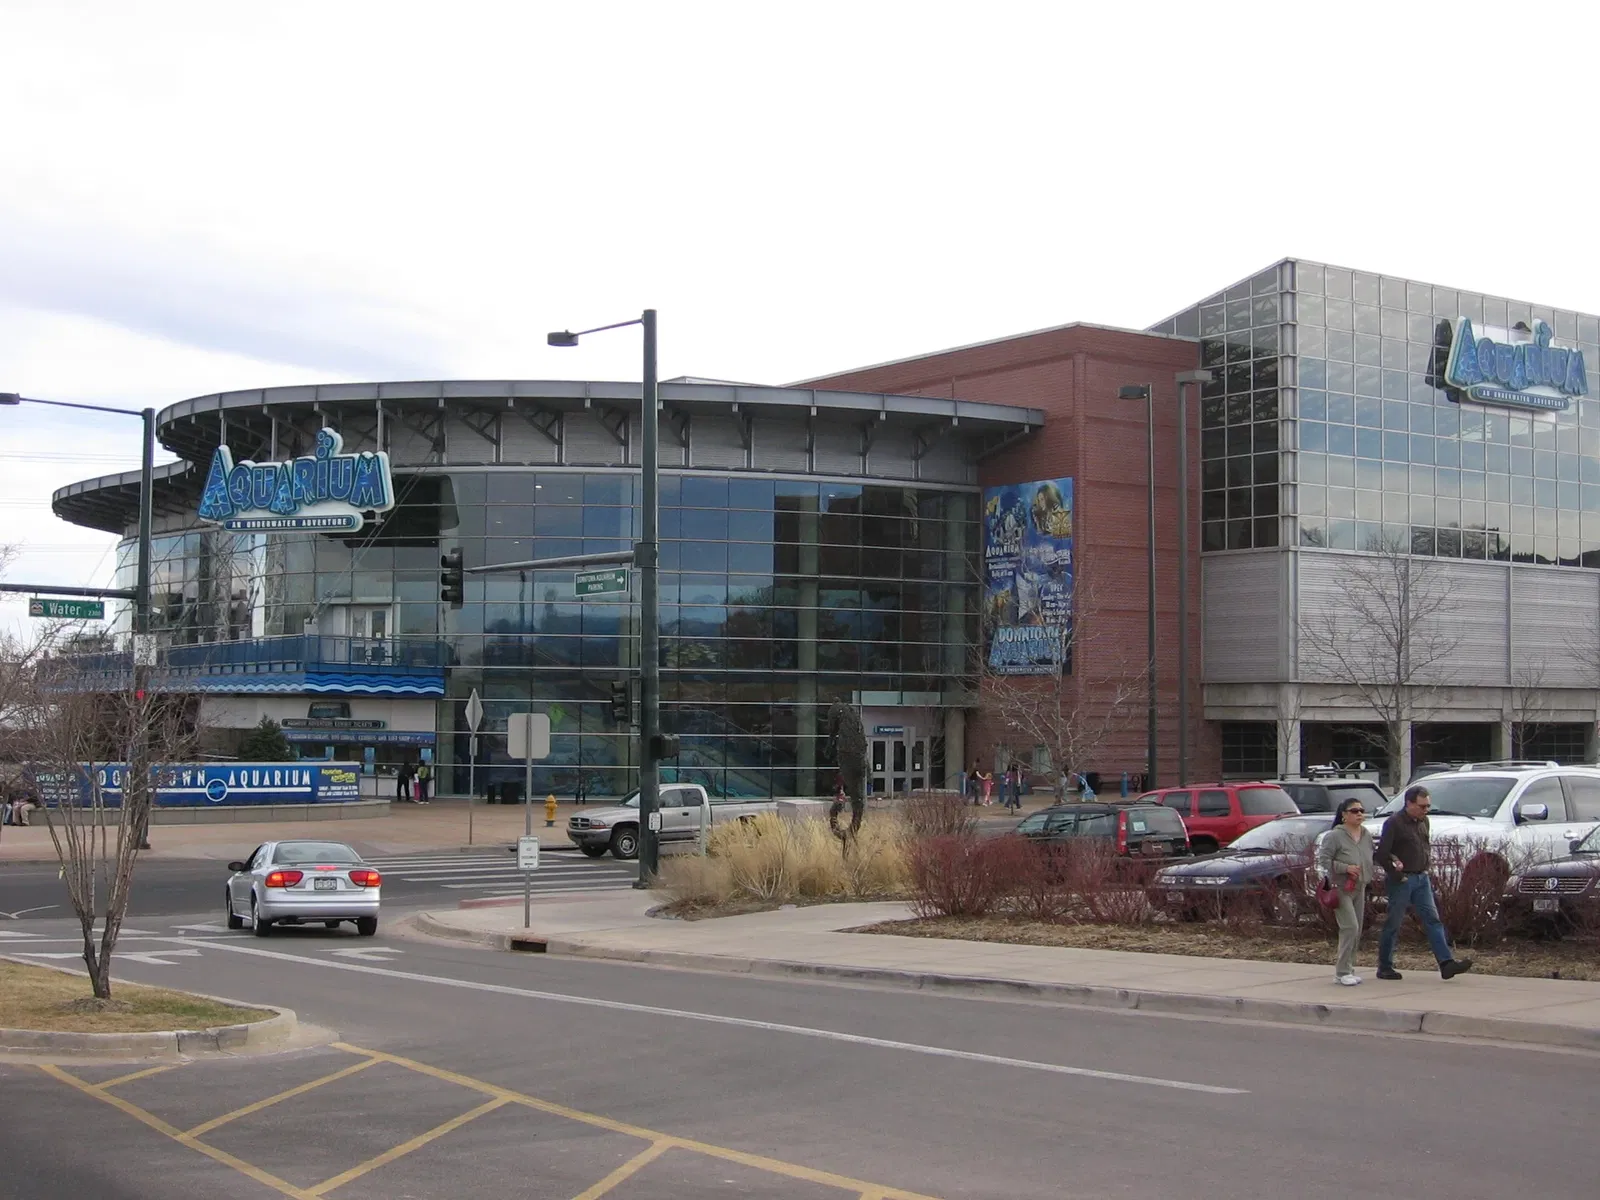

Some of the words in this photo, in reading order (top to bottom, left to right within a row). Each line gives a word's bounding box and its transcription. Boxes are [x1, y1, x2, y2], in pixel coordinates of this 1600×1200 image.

[1451, 317, 1588, 396] AQUARIUM
[198, 443, 390, 520] AQUARIUM
[231, 519, 242, 529] AN
[246, 518, 297, 528] UNDERWATER
[302, 517, 348, 527] ADVENTURE
[49, 602, 81, 616] Water
[228, 769, 311, 788] AQUARIUM
